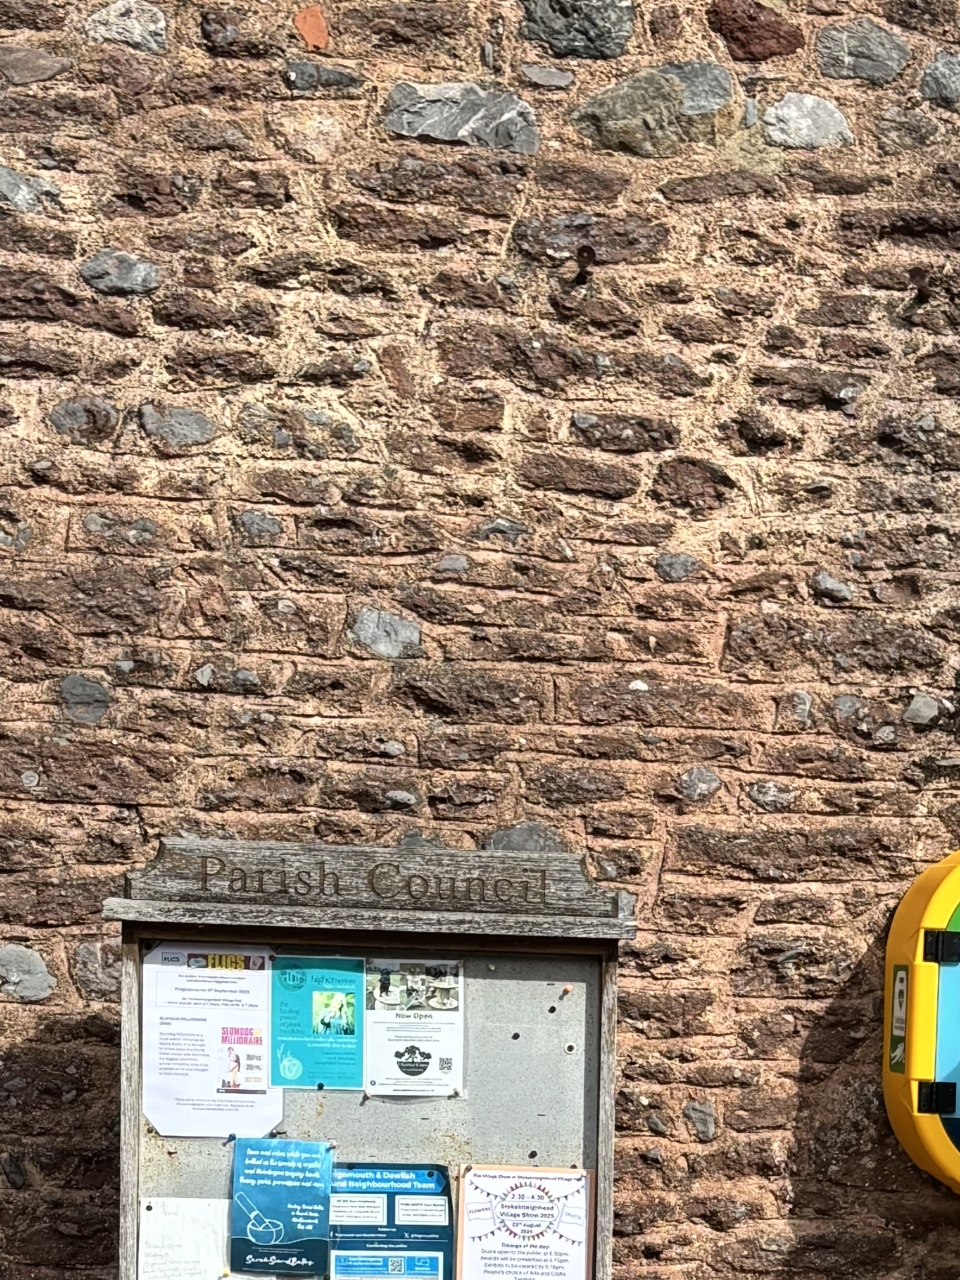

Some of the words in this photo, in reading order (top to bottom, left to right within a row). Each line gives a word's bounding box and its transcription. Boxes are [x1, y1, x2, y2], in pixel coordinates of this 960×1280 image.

[200, 856, 342, 898] Parish
[367, 862, 549, 903] Council
[207, 953, 245, 971] FLICS
[413, 1012, 433, 1020] Open
[221, 1026, 254, 1036] SLUMDOG
[221, 1036, 263, 1045] MILLIONAIRE
[383, 1171, 416, 1179] Dawlish
[348, 1180, 412, 1190] Neighbourhood
